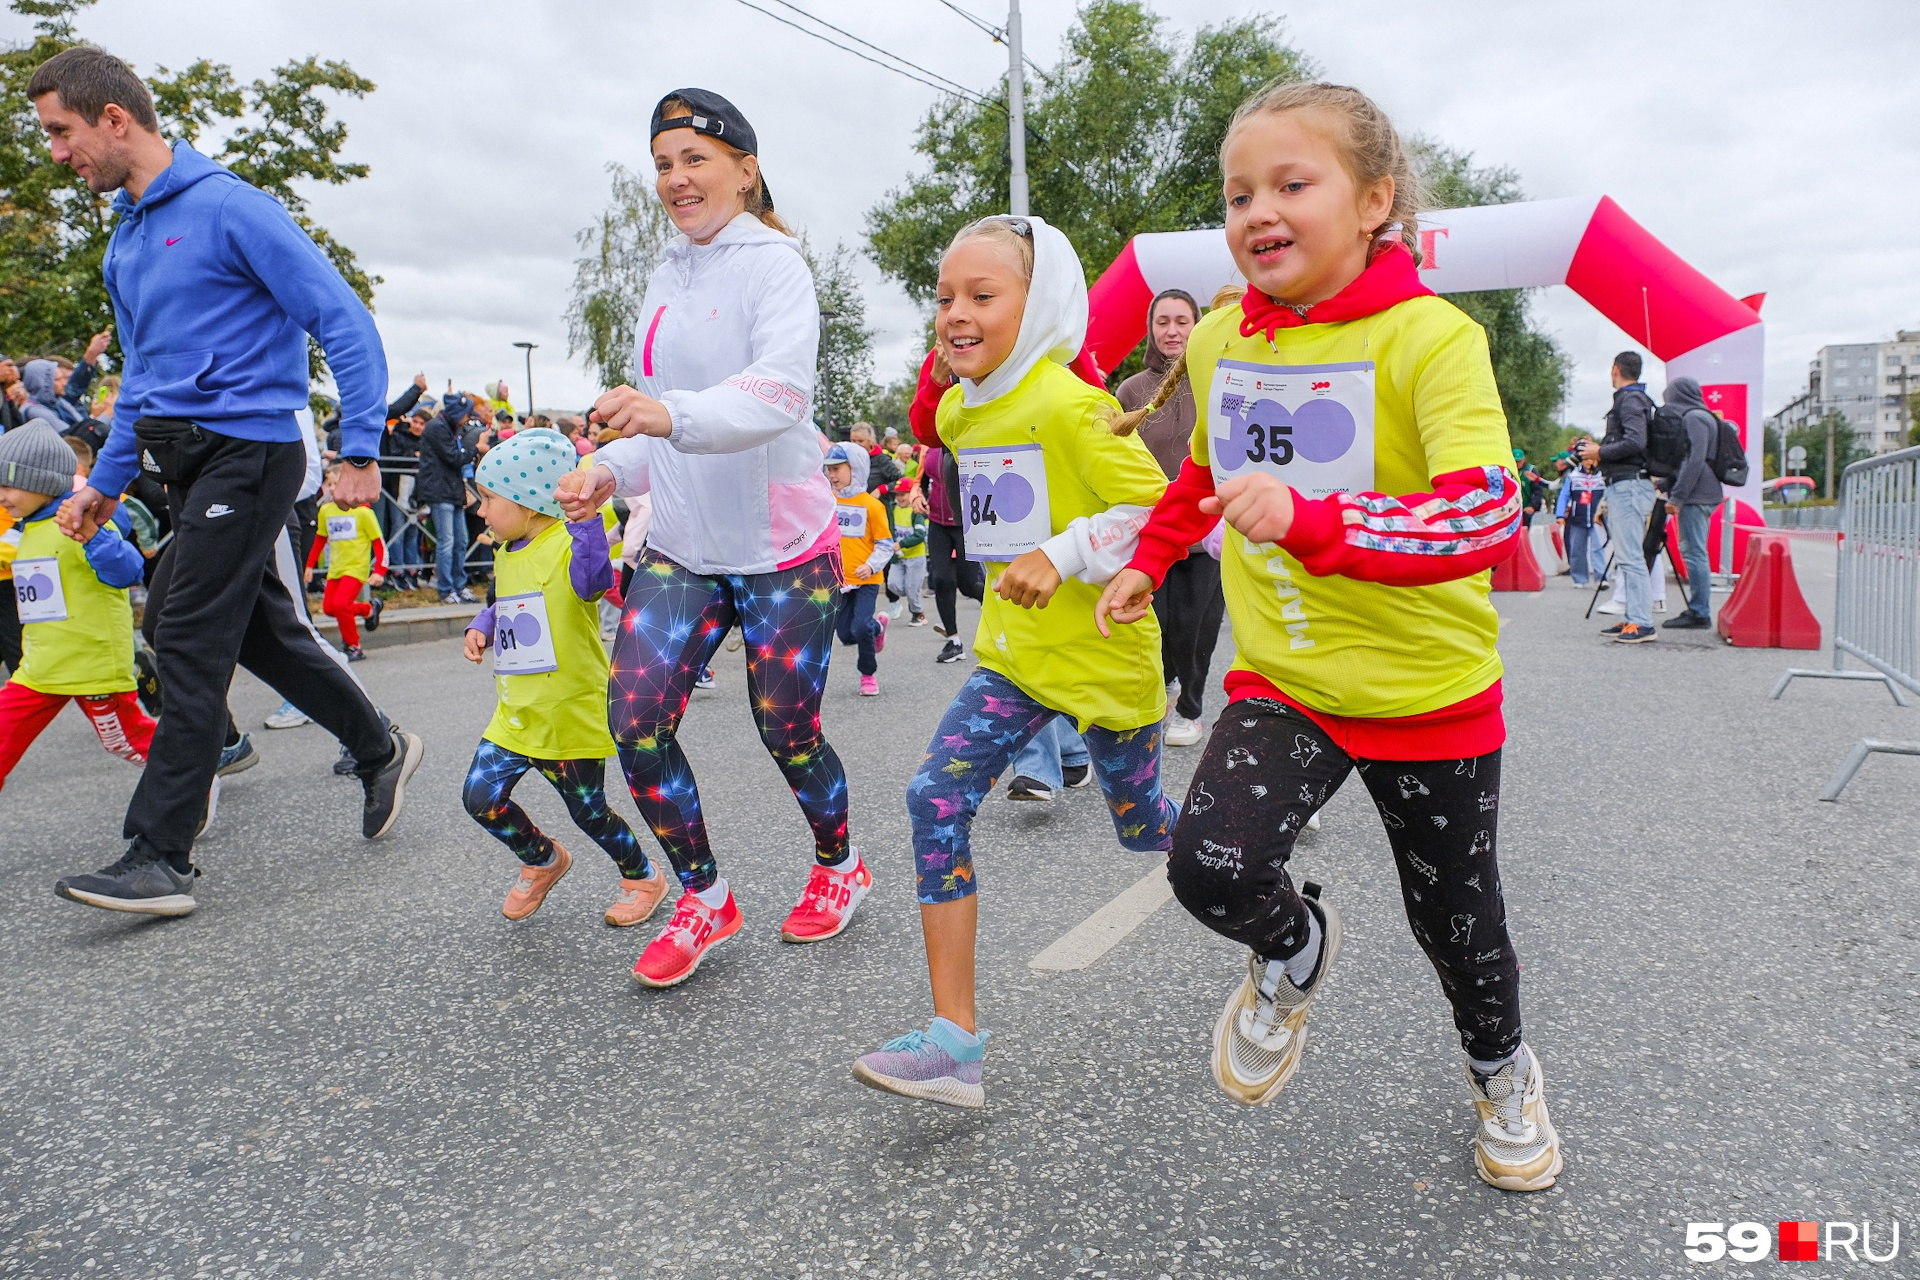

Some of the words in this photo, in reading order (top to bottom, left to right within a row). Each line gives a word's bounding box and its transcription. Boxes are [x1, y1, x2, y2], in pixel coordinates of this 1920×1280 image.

[1246, 423, 1294, 466] 35
[210, 503, 230, 513] NIKE
[970, 494, 997, 526] 84
[838, 517, 850, 527] 28
[782, 529, 808, 553] SPORT
[18, 585, 37, 603] 50
[500, 628, 517, 651] 81
